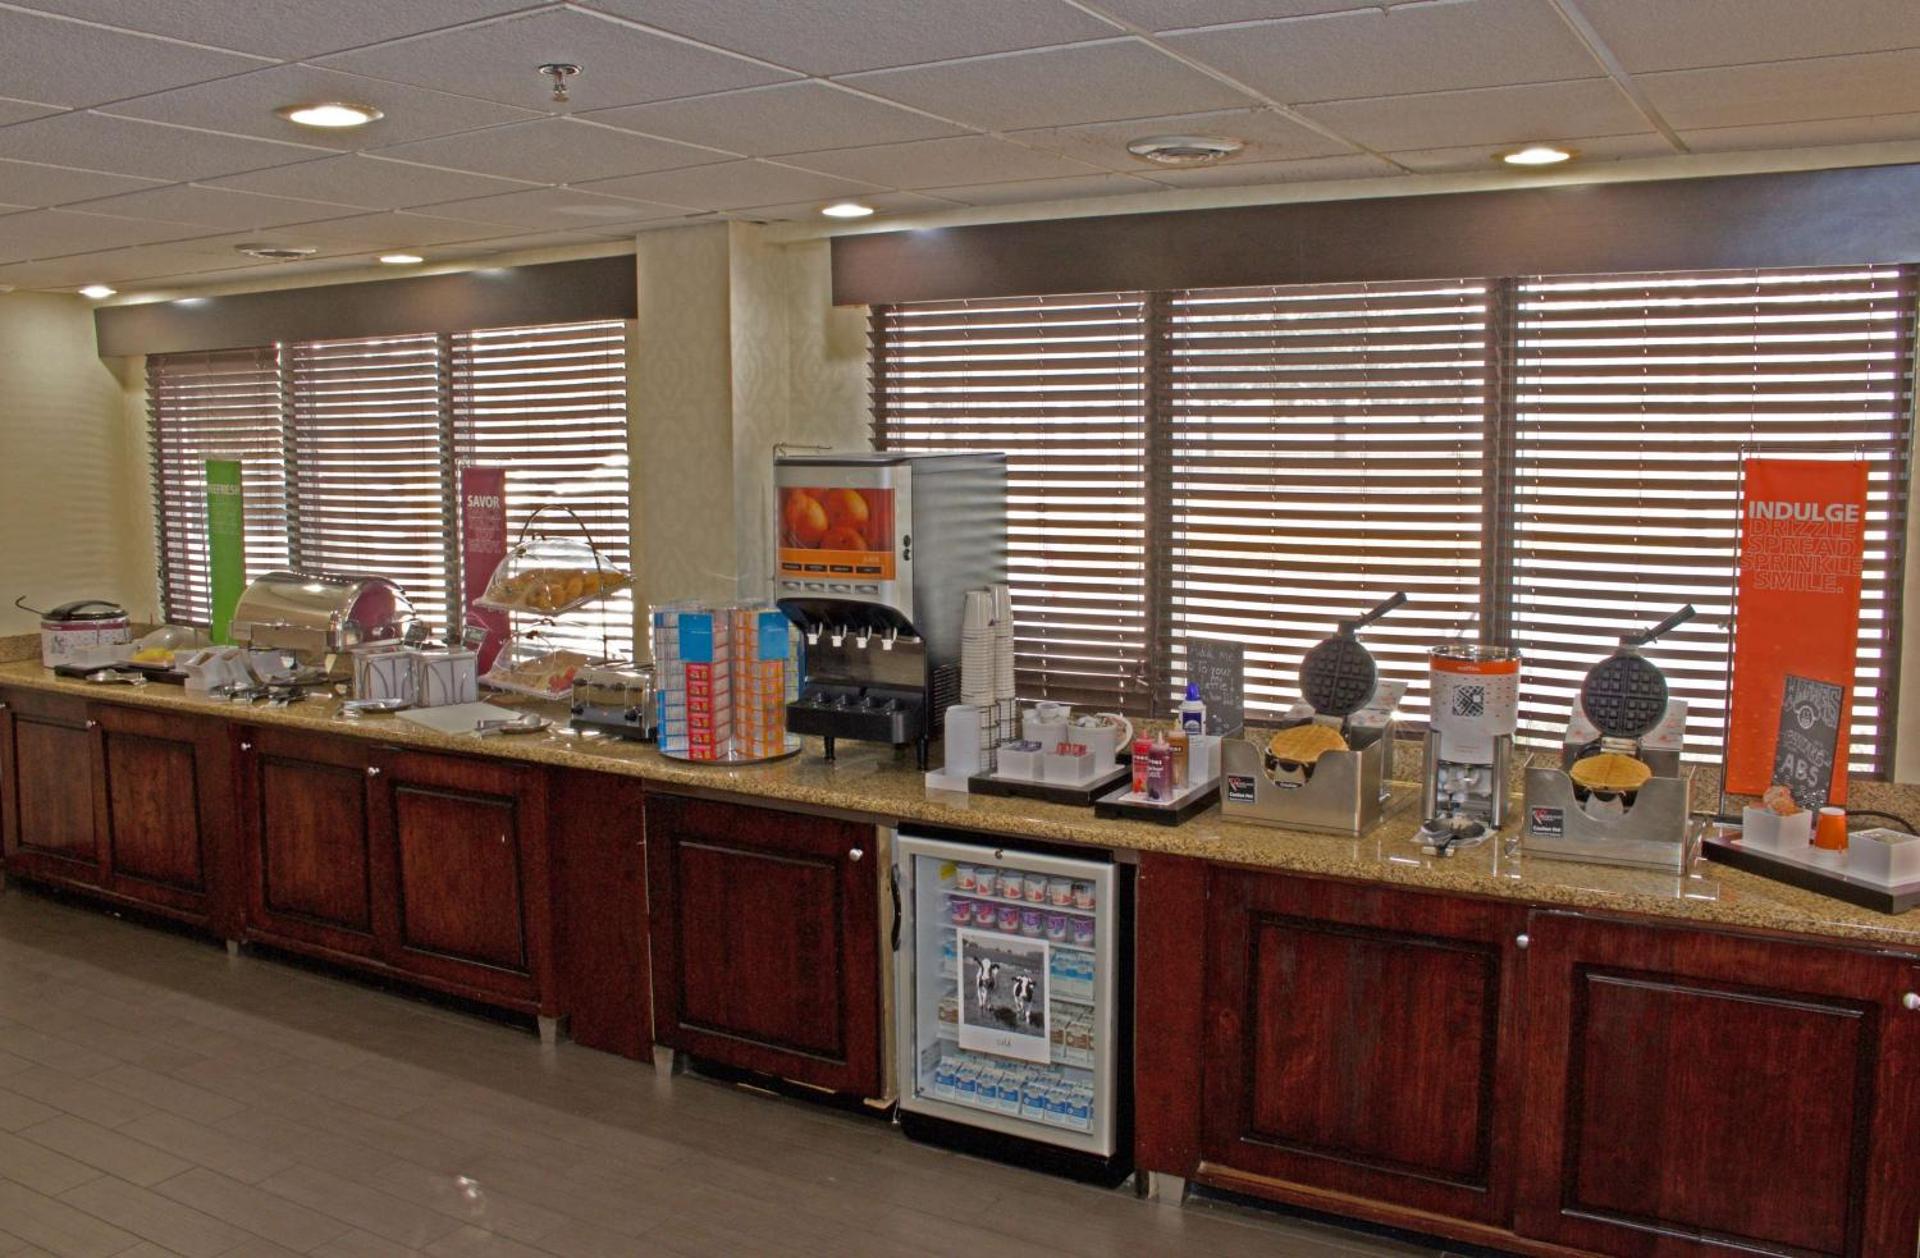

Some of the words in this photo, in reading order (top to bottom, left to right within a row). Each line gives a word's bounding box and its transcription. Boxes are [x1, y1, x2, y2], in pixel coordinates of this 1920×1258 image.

[467, 494, 500, 509] SAVOR
[1748, 500, 1860, 523] INDULGE
[1749, 518, 1858, 539] DRIZZLE
[1747, 535, 1857, 557] SPREAD
[1741, 551, 1864, 576] SPRINKLE
[1753, 570, 1844, 593] SMILE.
[1780, 753, 1819, 788] ABS
